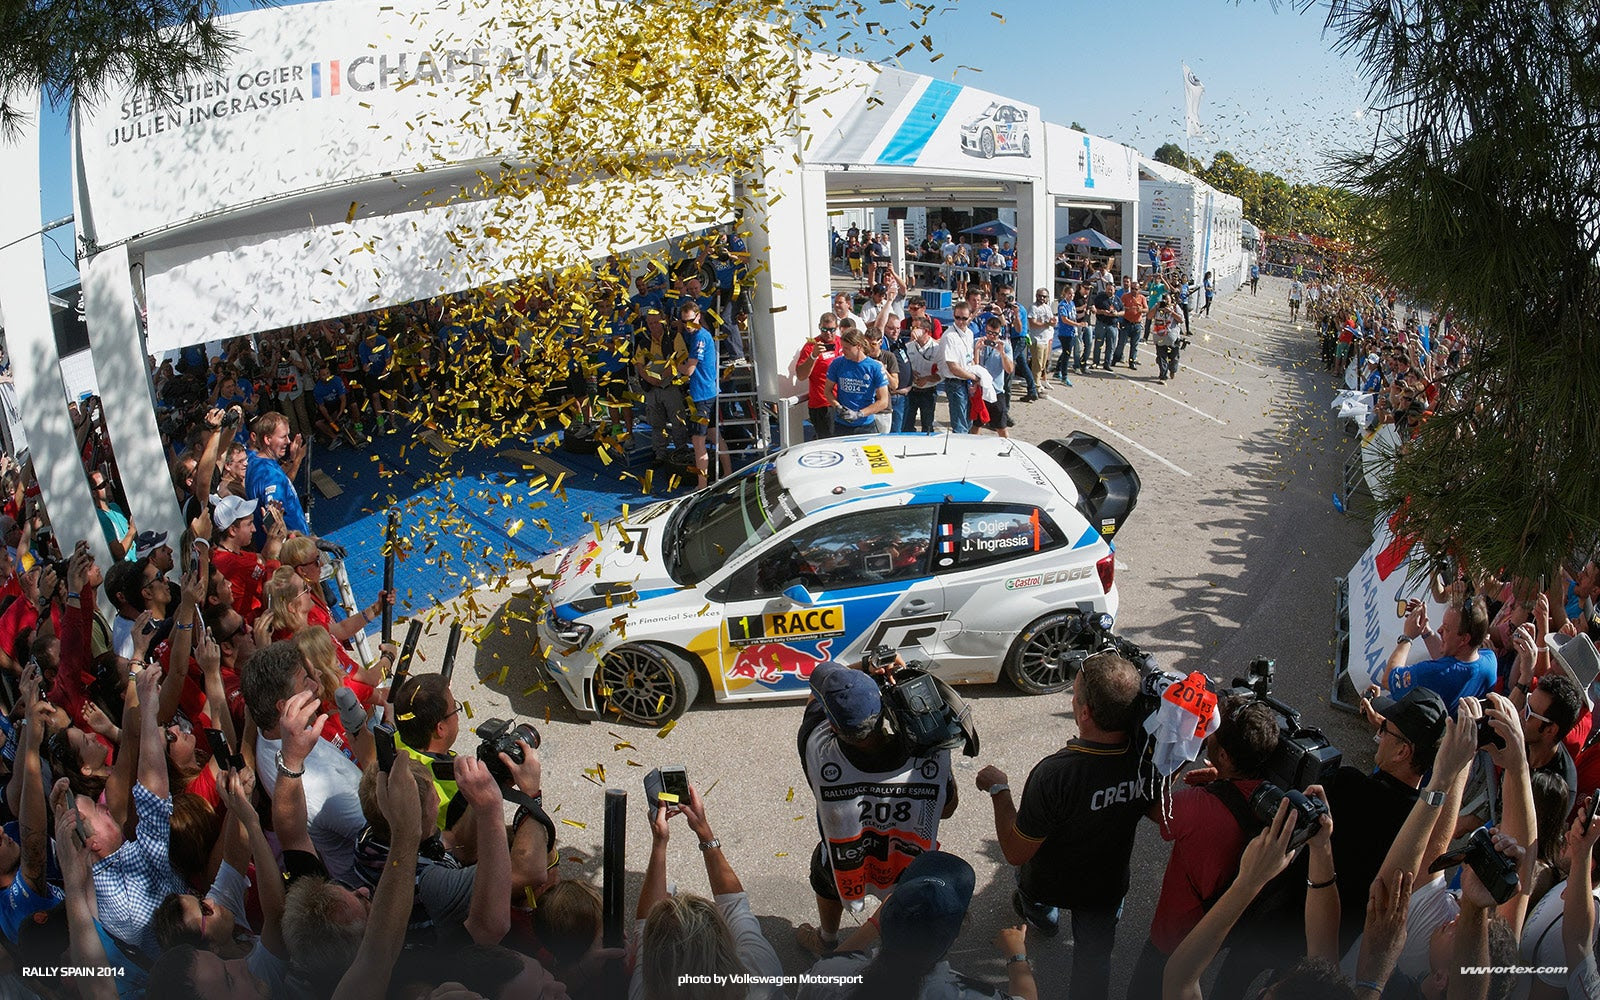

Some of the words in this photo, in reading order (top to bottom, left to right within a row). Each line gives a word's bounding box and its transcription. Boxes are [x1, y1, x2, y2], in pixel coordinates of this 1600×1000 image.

[237, 65, 303, 91] OGIER
[109, 111, 181, 147] JULIEN
[189, 86, 304, 125] INGRASSIA
[863, 449, 889, 468] RACC
[961, 522, 974, 534] S.
[978, 519, 1010, 534] Ogier
[1029, 508, 1040, 551] 1
[962, 539, 974, 551] J.
[976, 535, 1029, 552] Ingrassia
[1014, 575, 1041, 588] Castrol
[1043, 565, 1094, 585] EDGE
[639, 612, 680, 625] Financial
[738, 616, 750, 639] 1
[772, 609, 835, 635] RACC
[825, 769, 838, 777] ESP
[824, 786, 868, 798] RALLYRACC
[870, 786, 895, 795] RALLY
[896, 786, 907, 795] DE
[1090, 777, 1147, 811] CREW
[857, 800, 912, 824] 208
